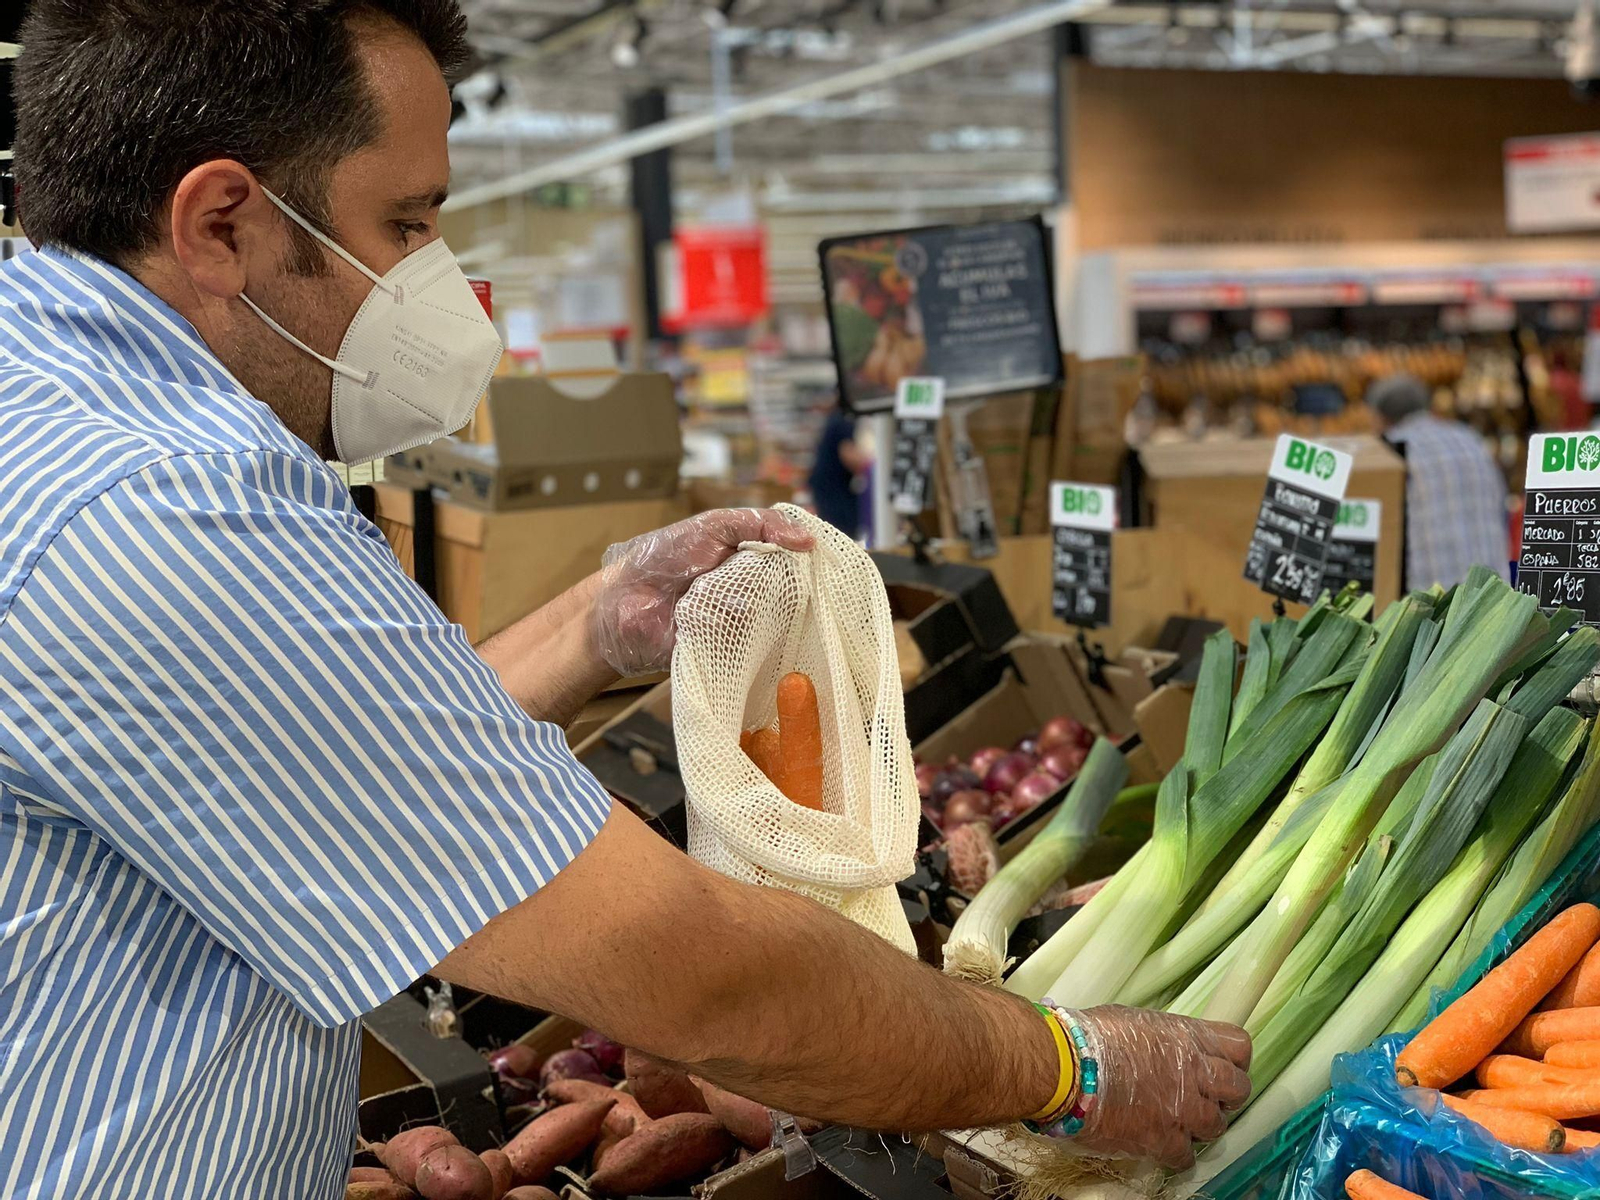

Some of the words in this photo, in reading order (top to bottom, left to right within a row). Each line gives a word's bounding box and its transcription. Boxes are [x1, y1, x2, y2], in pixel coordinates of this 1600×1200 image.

[1284, 439, 1337, 481] BIO
[1542, 436, 1600, 473] BIO
[1063, 487, 1103, 515] BIO
[1535, 492, 1597, 515] PUERROS
[1524, 526, 1565, 541] MERCADO
[1523, 552, 1560, 568] ESPAÑA
[1576, 554, 1599, 568] 582
